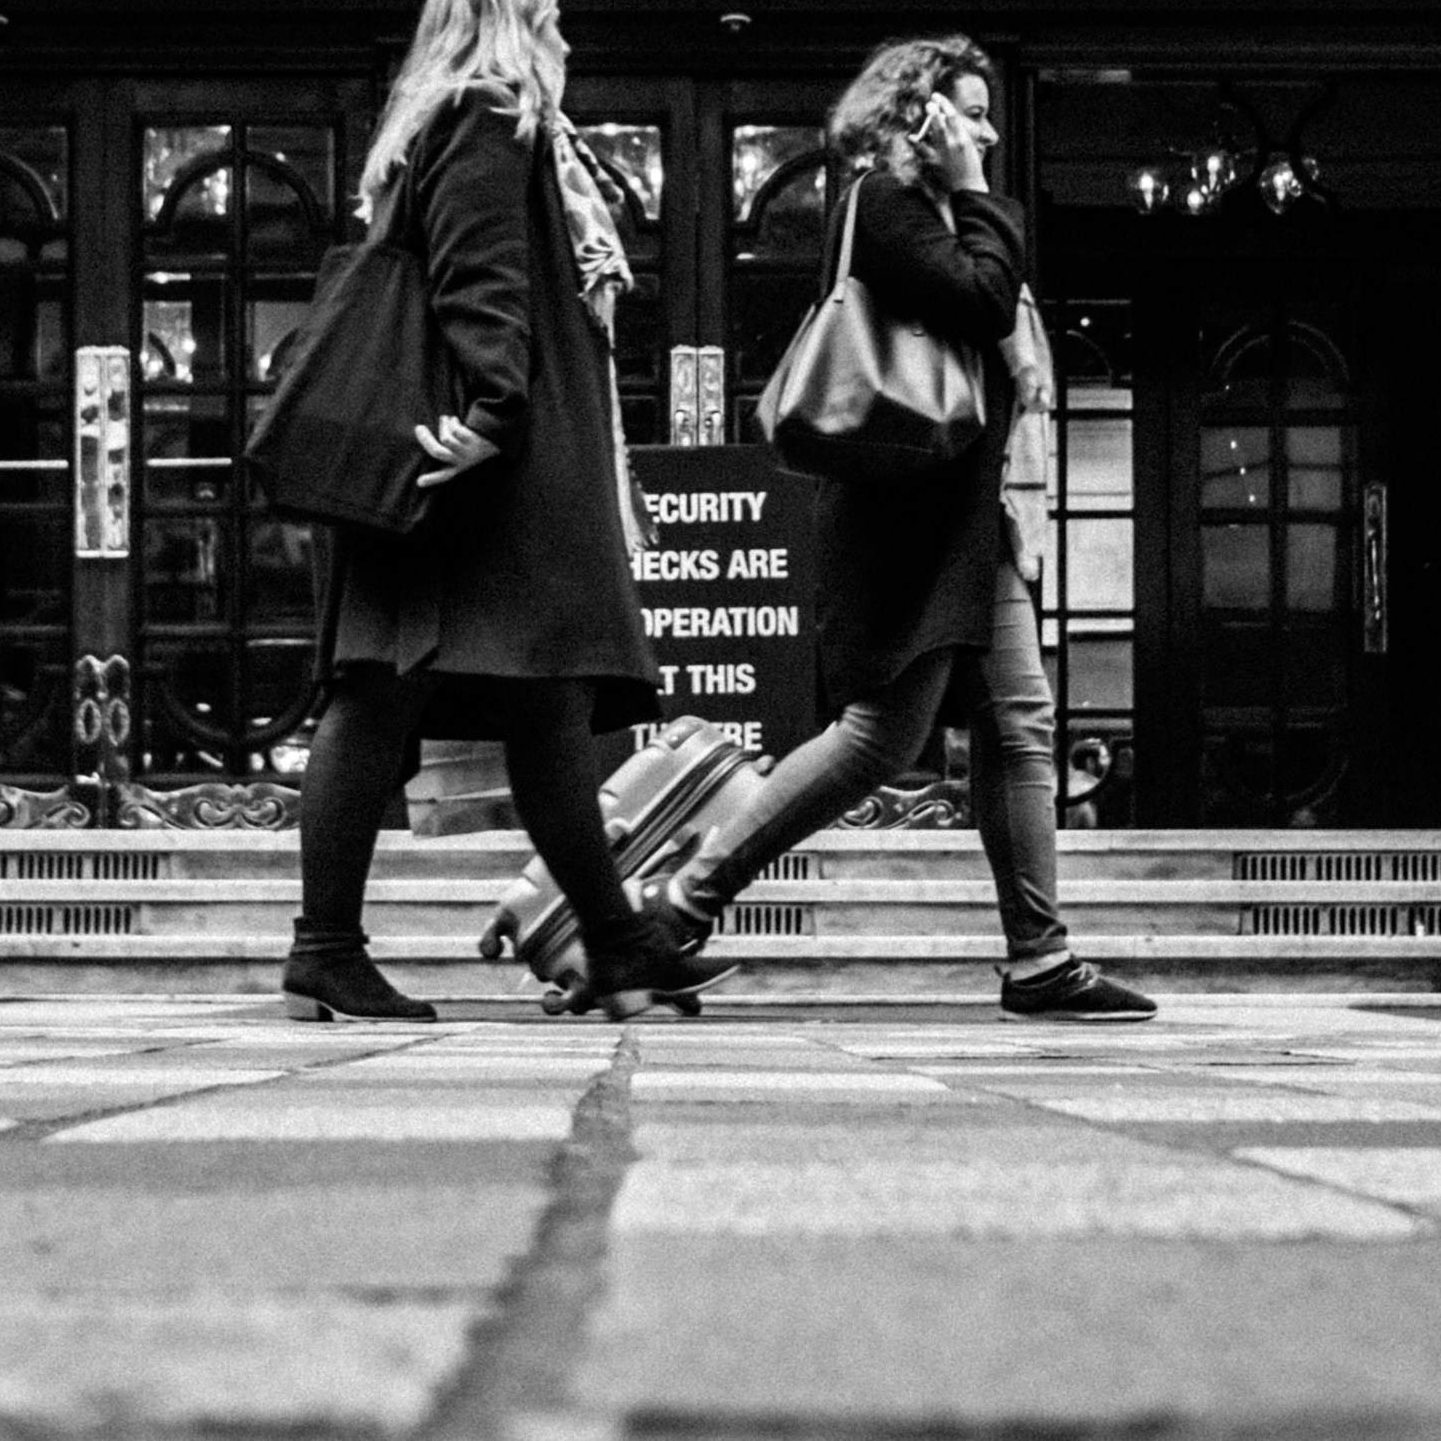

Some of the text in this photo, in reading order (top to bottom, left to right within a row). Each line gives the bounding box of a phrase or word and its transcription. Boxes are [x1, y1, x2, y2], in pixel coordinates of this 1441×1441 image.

[641, 492, 767, 524] ECURITY
[631, 548, 789, 581] HECKS ARE
[657, 663, 757, 696] T THIS
